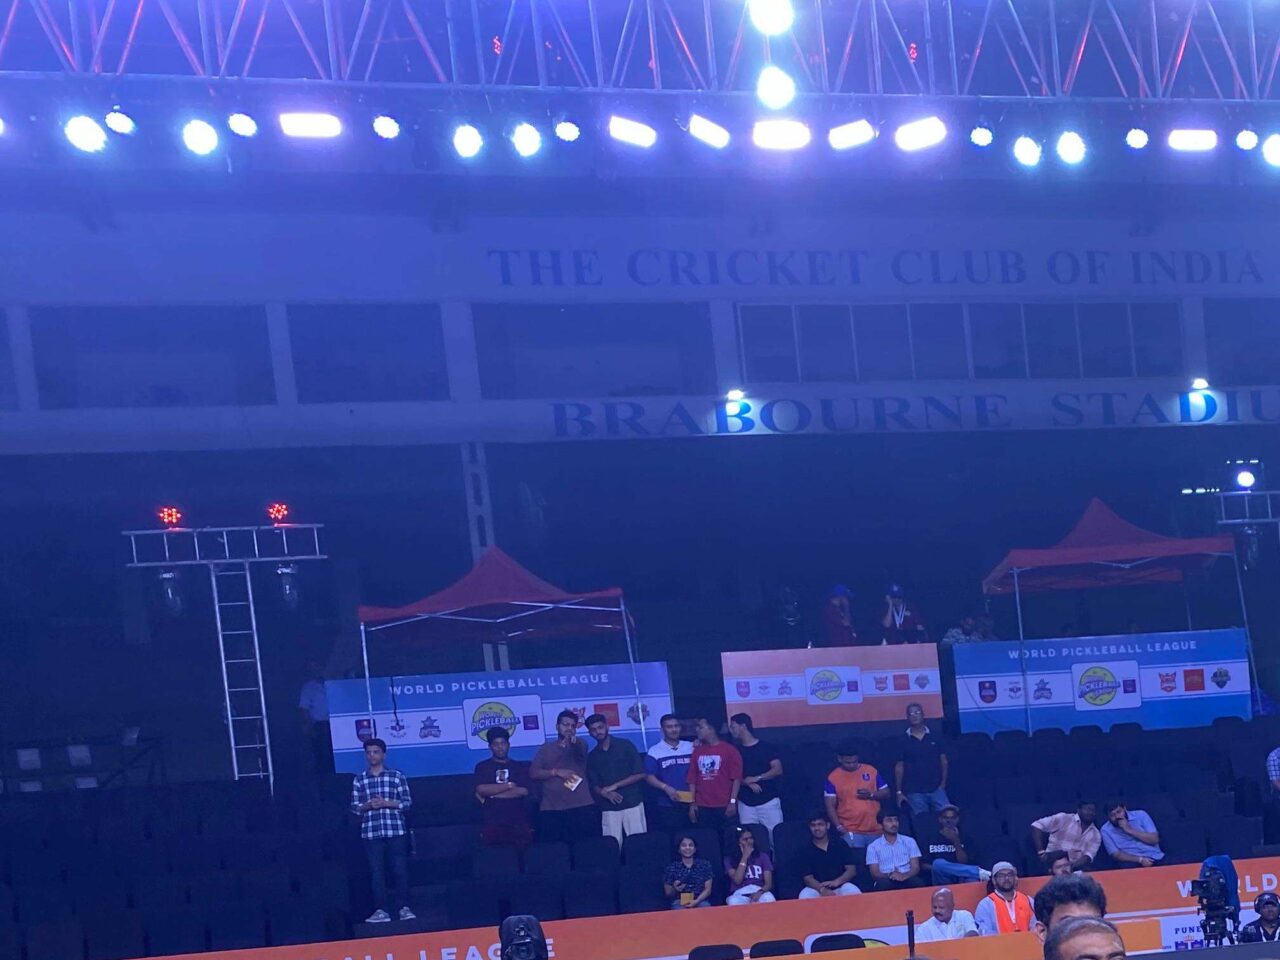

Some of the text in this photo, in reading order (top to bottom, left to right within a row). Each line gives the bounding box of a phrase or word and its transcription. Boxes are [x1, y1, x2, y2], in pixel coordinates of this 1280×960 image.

[488, 249, 604, 287] THE
[626, 249, 869, 287] CRICKET
[891, 249, 1028, 287] CLUB
[1047, 250, 1113, 286] OF
[1129, 250, 1265, 286] INDIA
[552, 395, 1012, 438] BRABOURNE
[1008, 640, 1197, 660] WORLD PICKLEBALL LEAGUE
[389, 673, 609, 696] WORLD PICKLEBALL LEAGUE
[745, 864, 762, 879] AP
[1176, 873, 1279, 898] WLD
[1174, 926, 1202, 935] PUNE
